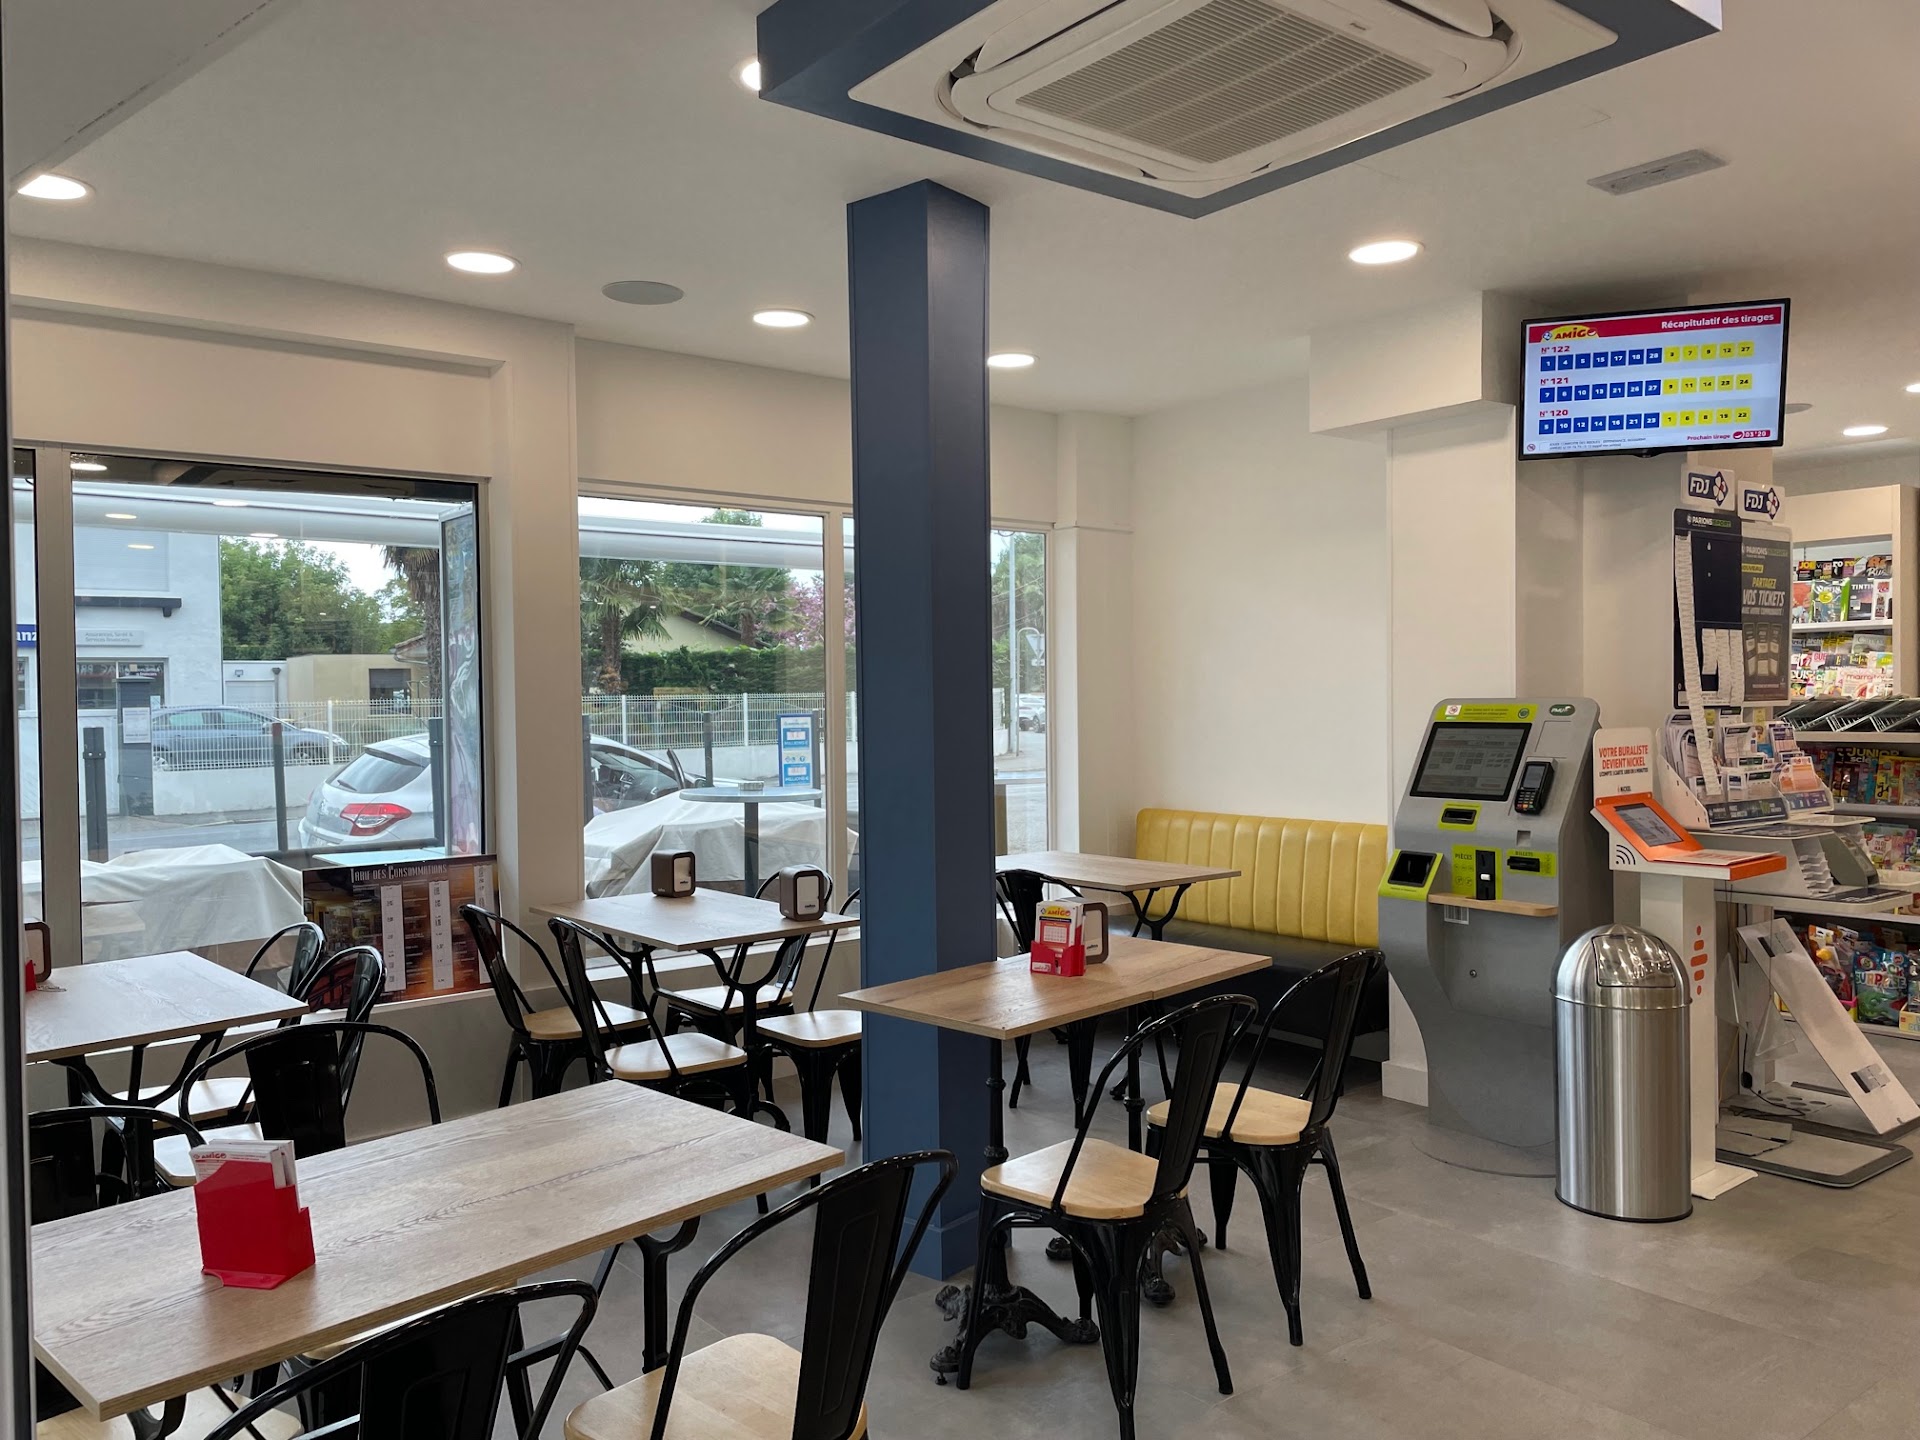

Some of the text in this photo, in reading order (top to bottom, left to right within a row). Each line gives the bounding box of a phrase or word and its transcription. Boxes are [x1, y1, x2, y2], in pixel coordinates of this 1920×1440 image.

[1662, 314, 1774, 329] Récapitulatif des tirages
[1555, 327, 1597, 340] AMIGO
[1690, 477, 1710, 494] FDJ
[1745, 494, 1763, 509] FDJ
[1692, 516, 1712, 526] PARIONS
[1746, 546, 1768, 557] PARIONS
[1743, 589, 1785, 607] VOS TICKETS
[1599, 745, 1648, 758] VOTRE BURALISTE
[1602, 757, 1646, 769] DEVIENT NICKEL
